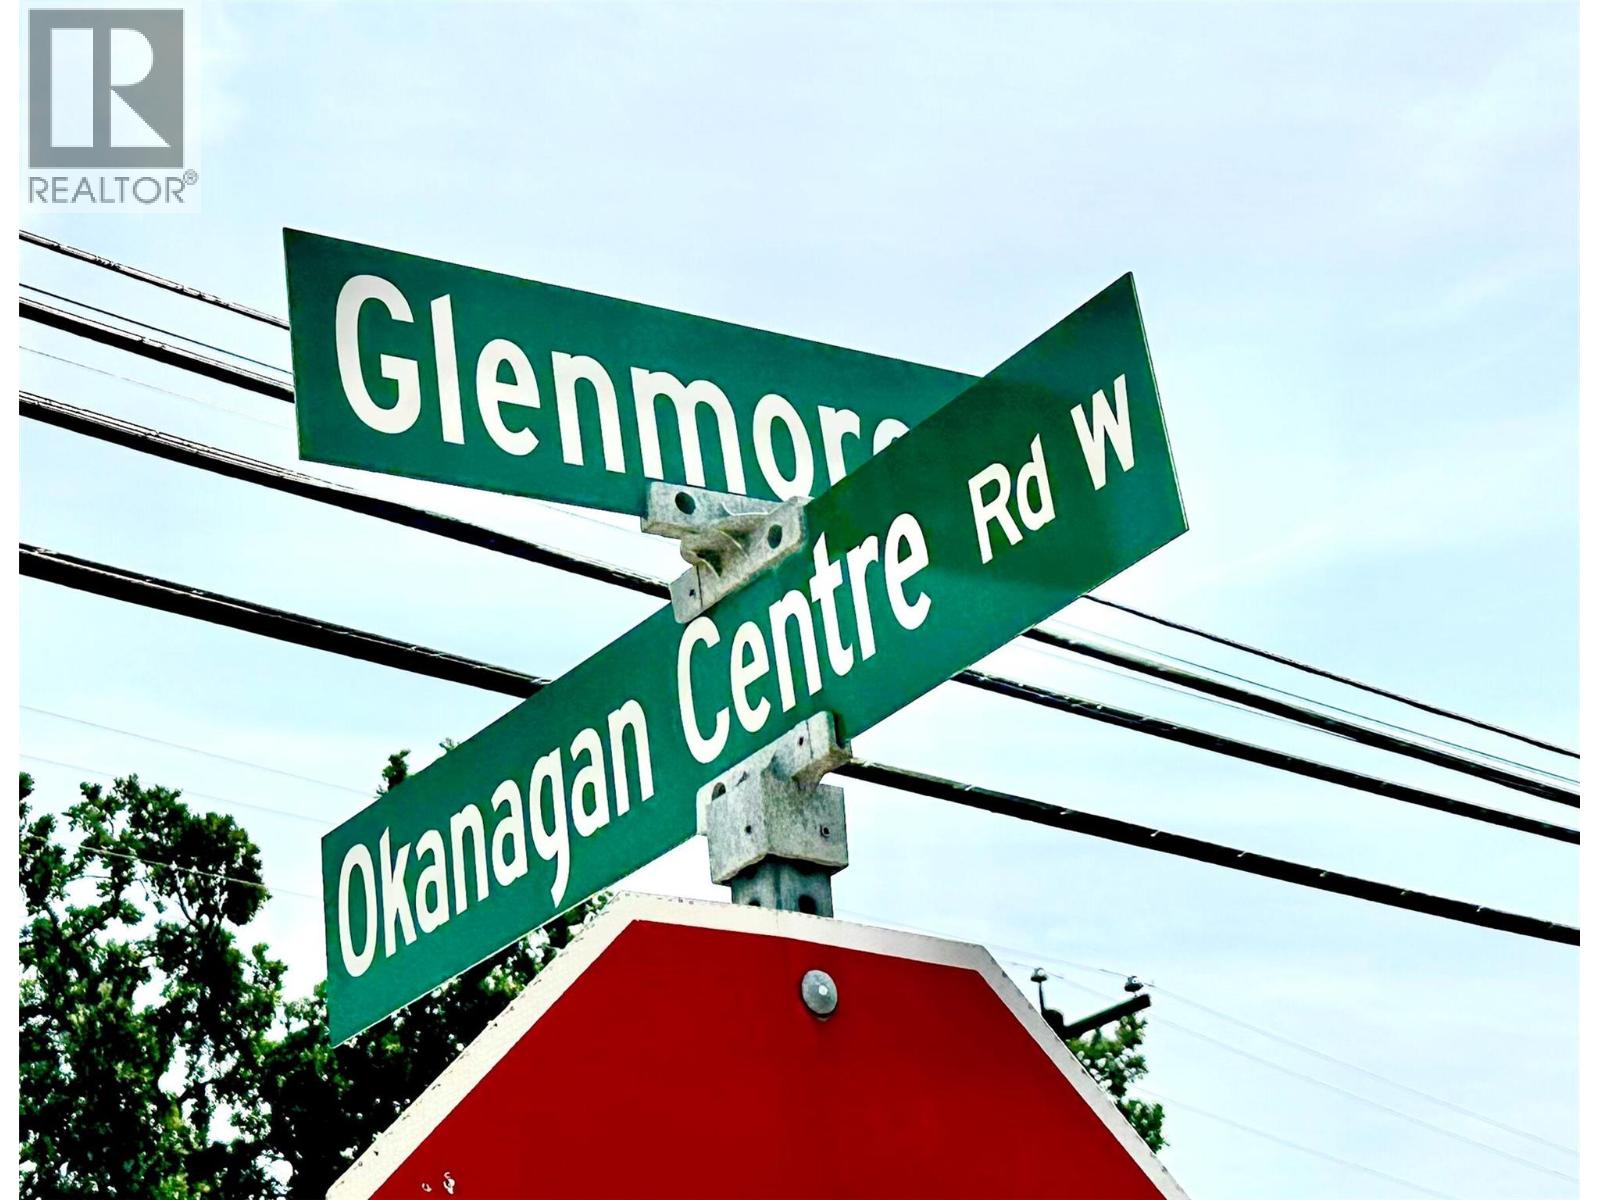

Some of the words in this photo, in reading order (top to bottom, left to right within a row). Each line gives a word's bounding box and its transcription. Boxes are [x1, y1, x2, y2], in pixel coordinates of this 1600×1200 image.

[338, 699, 655, 978] Okanagan
[677, 513, 931, 763] Centre
[968, 433, 1056, 564] Rd
[1070, 373, 1135, 491] W
